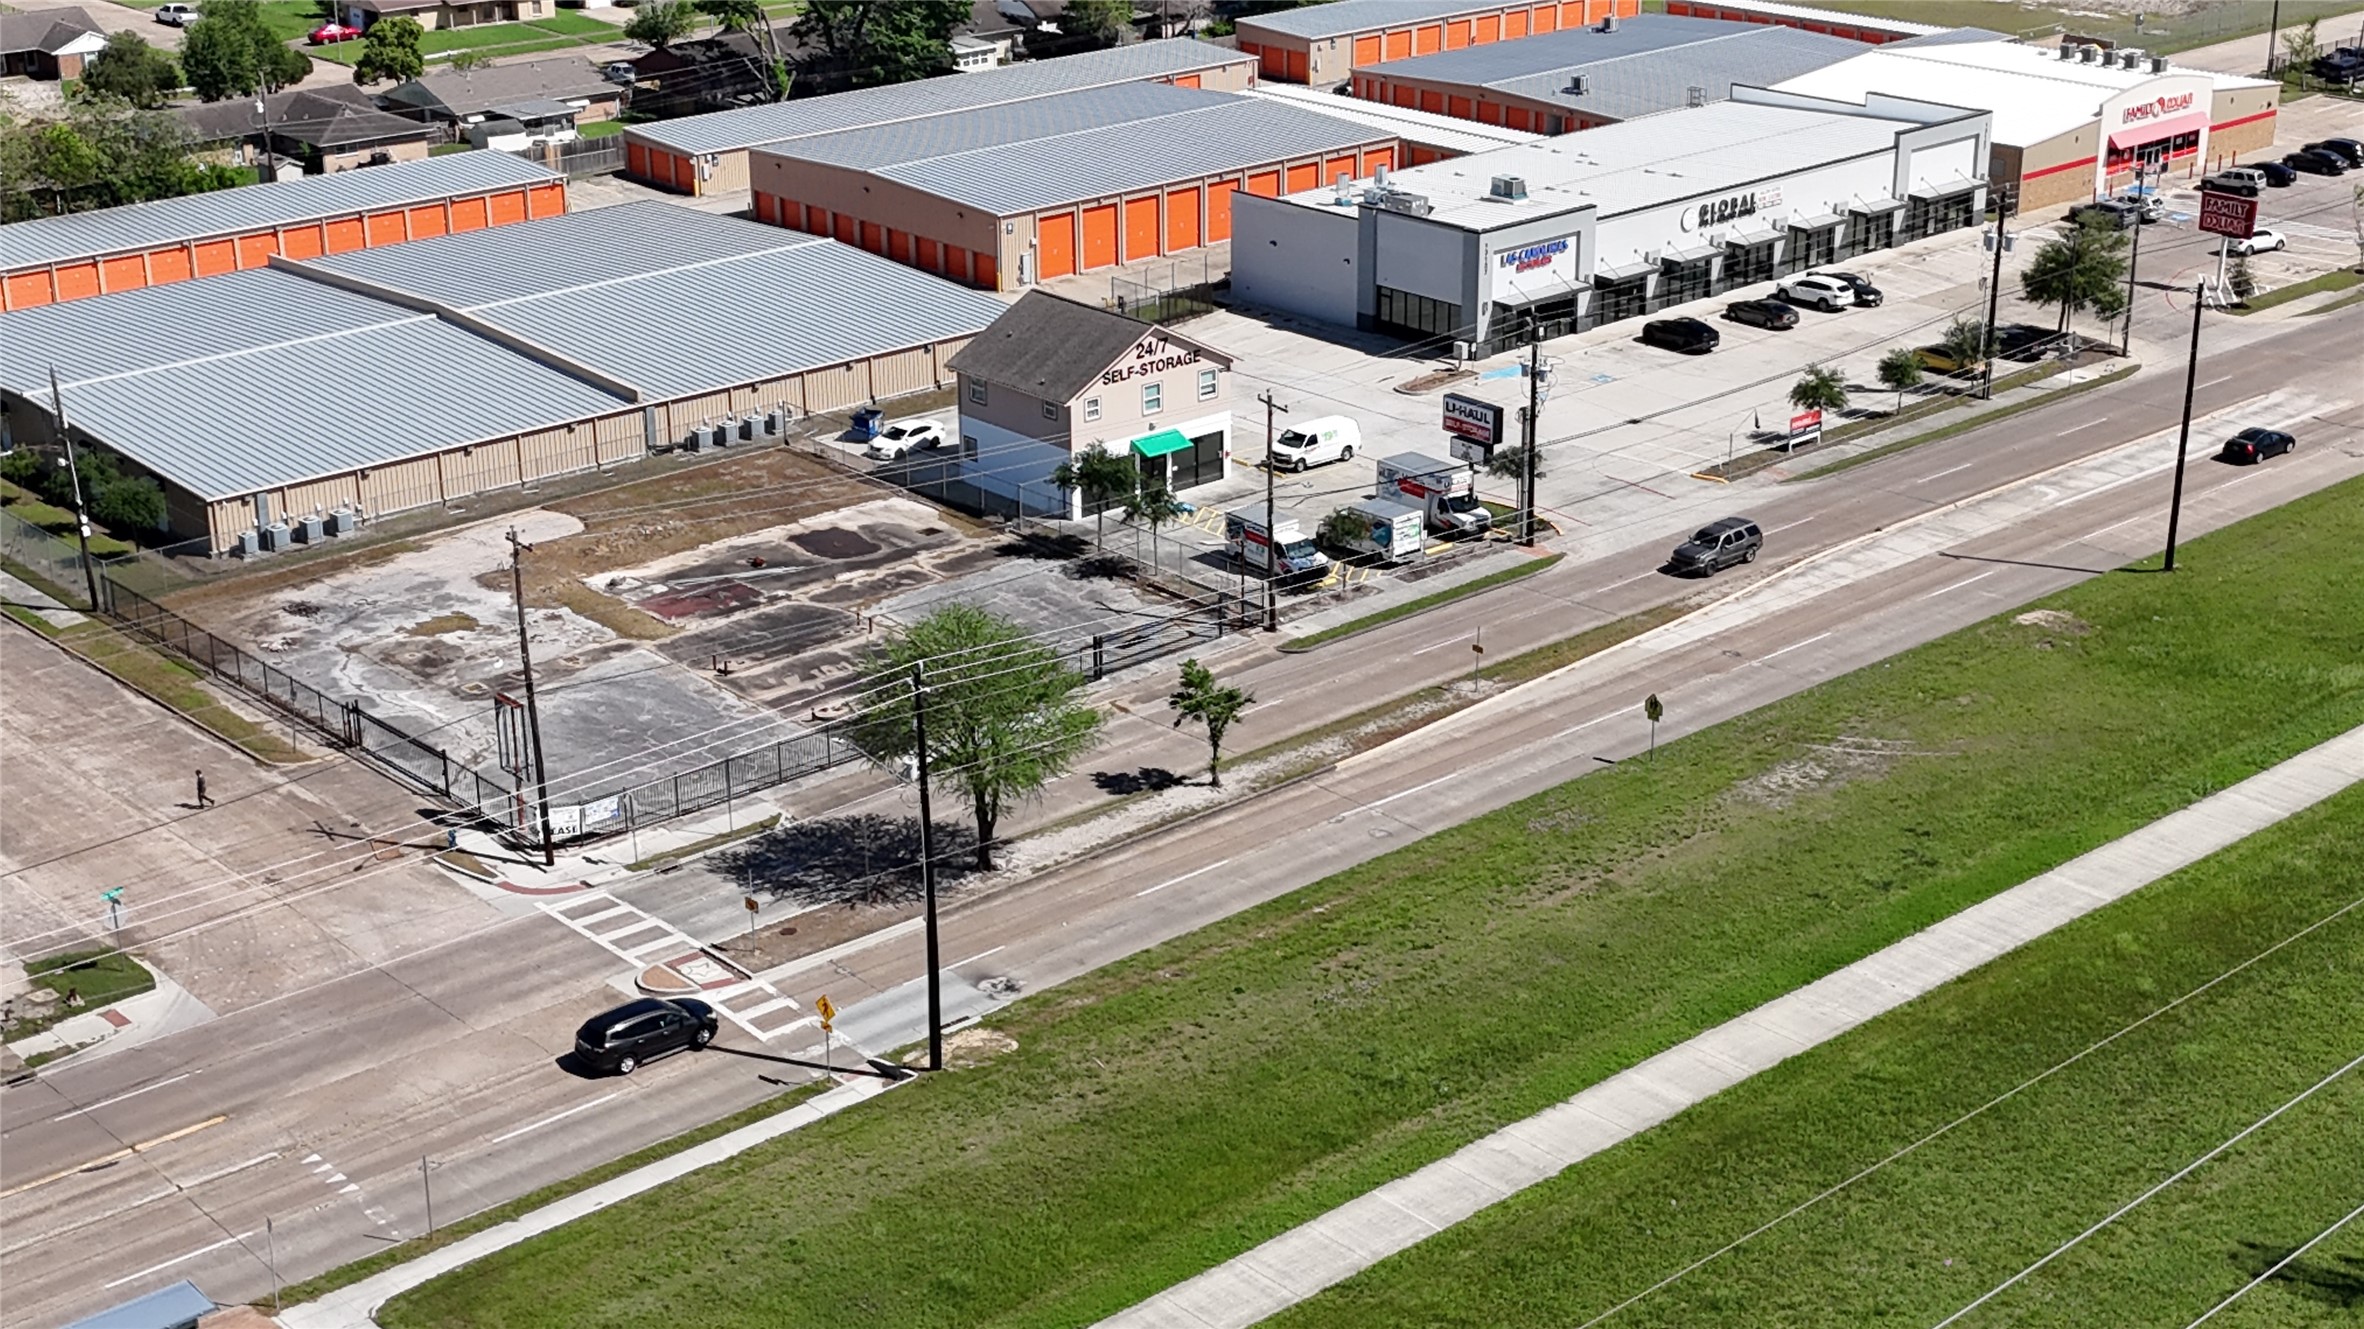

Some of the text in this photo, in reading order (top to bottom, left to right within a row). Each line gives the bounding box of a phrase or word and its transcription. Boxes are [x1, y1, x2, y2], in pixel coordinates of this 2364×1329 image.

[1699, 192, 1756, 227] GLOBAL
[2205, 197, 2250, 218] FAMILY
[2202, 213, 2246, 235] DOLLAR
[1136, 337, 1169, 360] 24/7
[1102, 349, 1201, 385] SELF-STORAGE
[1446, 401, 1490, 424] U-HAUL
